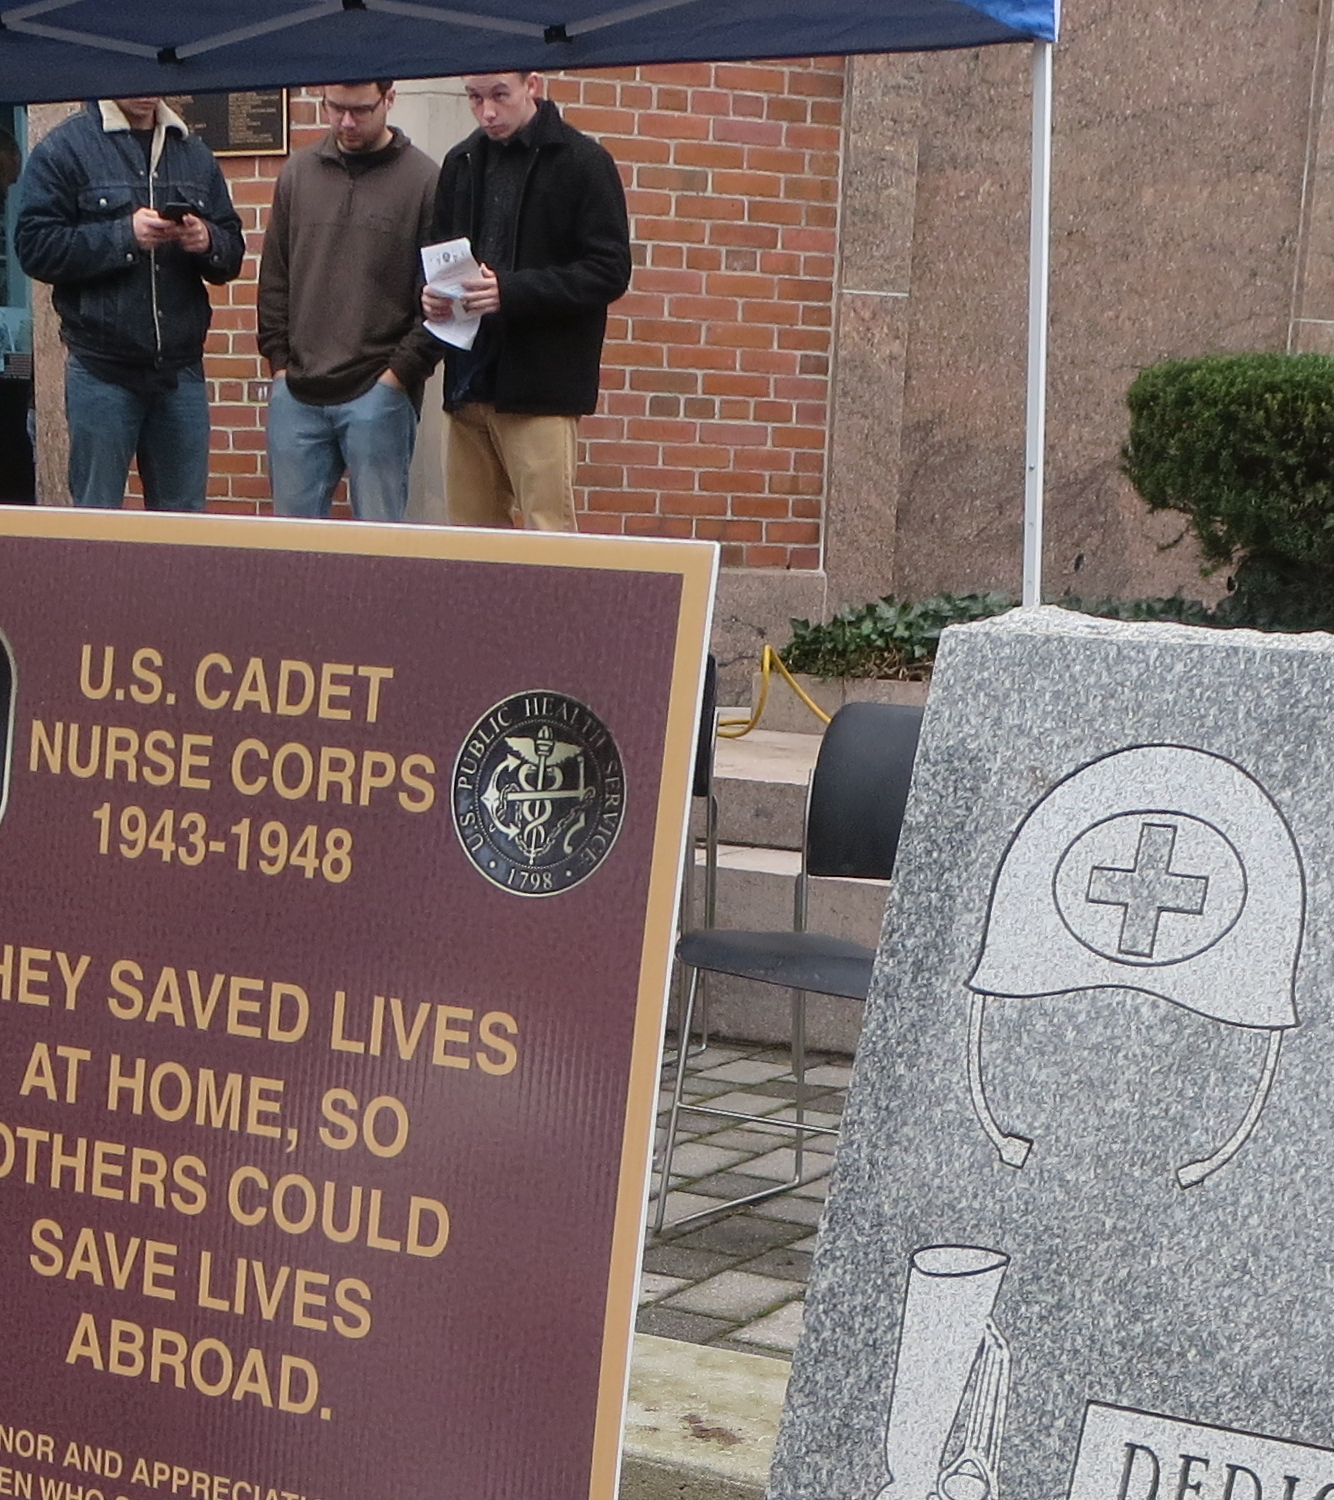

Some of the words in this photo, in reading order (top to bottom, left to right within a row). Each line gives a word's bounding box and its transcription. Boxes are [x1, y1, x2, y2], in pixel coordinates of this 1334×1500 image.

[80, 645, 175, 704] U.S.
[195, 653, 394, 722] CADET
[30, 720, 213, 789] NURSE
[232, 738, 435, 812] CORPS
[458, 706, 513, 789] PUBLIC
[93, 804, 352, 882] 1943-1948
[459, 805, 484, 852] U.S.
[580, 760, 621, 866] SERVICE
[507, 868, 553, 890] 1798
[108, 960, 309, 1042] SAVED
[331, 991, 518, 1075] LIVES
[20, 1042, 91, 1103] AT
[108, 1054, 298, 1152] HOME,
[319, 1088, 409, 1157] SO
[228, 1166, 449, 1257] COULD
[30, 1219, 177, 1300] SAVE
[199, 1251, 371, 1338] LIVES
[66, 1313, 331, 1419] ABROAD.
[64, 1443, 122, 1478] AND
